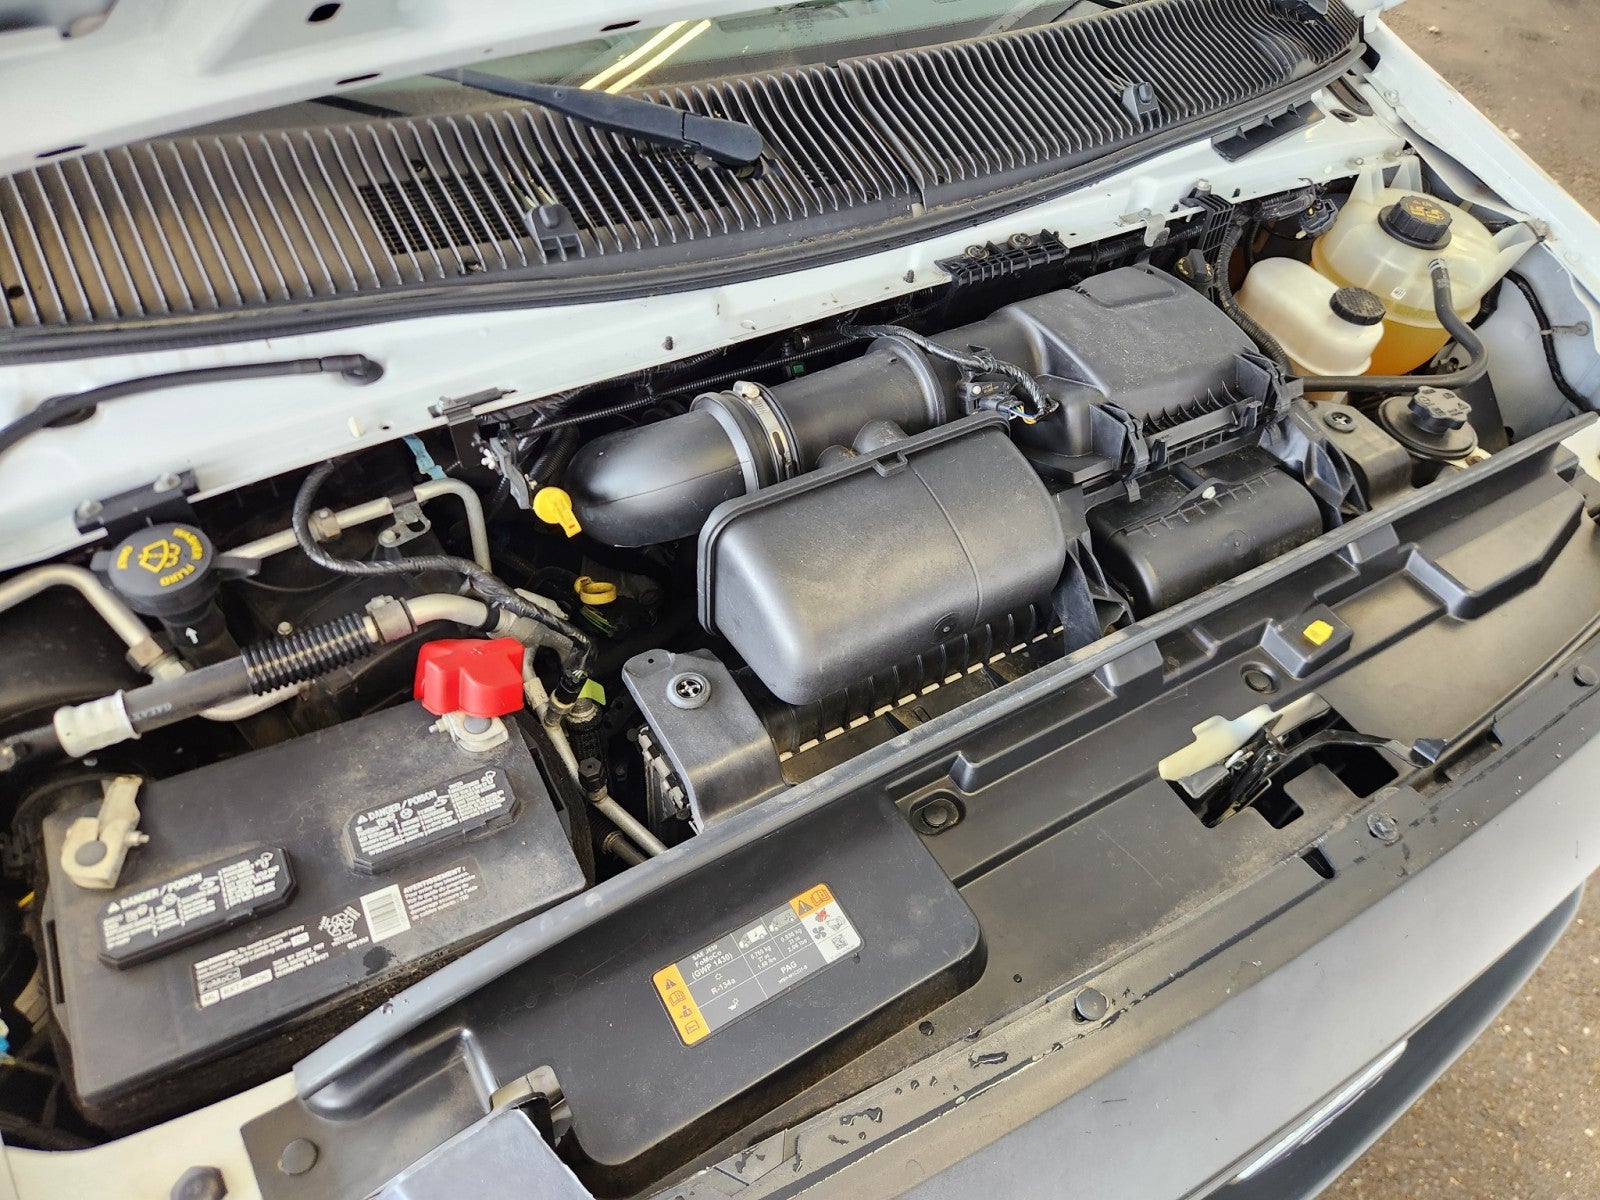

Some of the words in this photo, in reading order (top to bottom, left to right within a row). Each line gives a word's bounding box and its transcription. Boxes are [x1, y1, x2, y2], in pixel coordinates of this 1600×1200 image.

[691, 963, 712, 980] (GWP
[713, 952, 734, 967] 1430)
[694, 951, 722, 968] FoMoCo
[780, 960, 798, 974] PAG
[710, 978, 736, 996] R-134a
